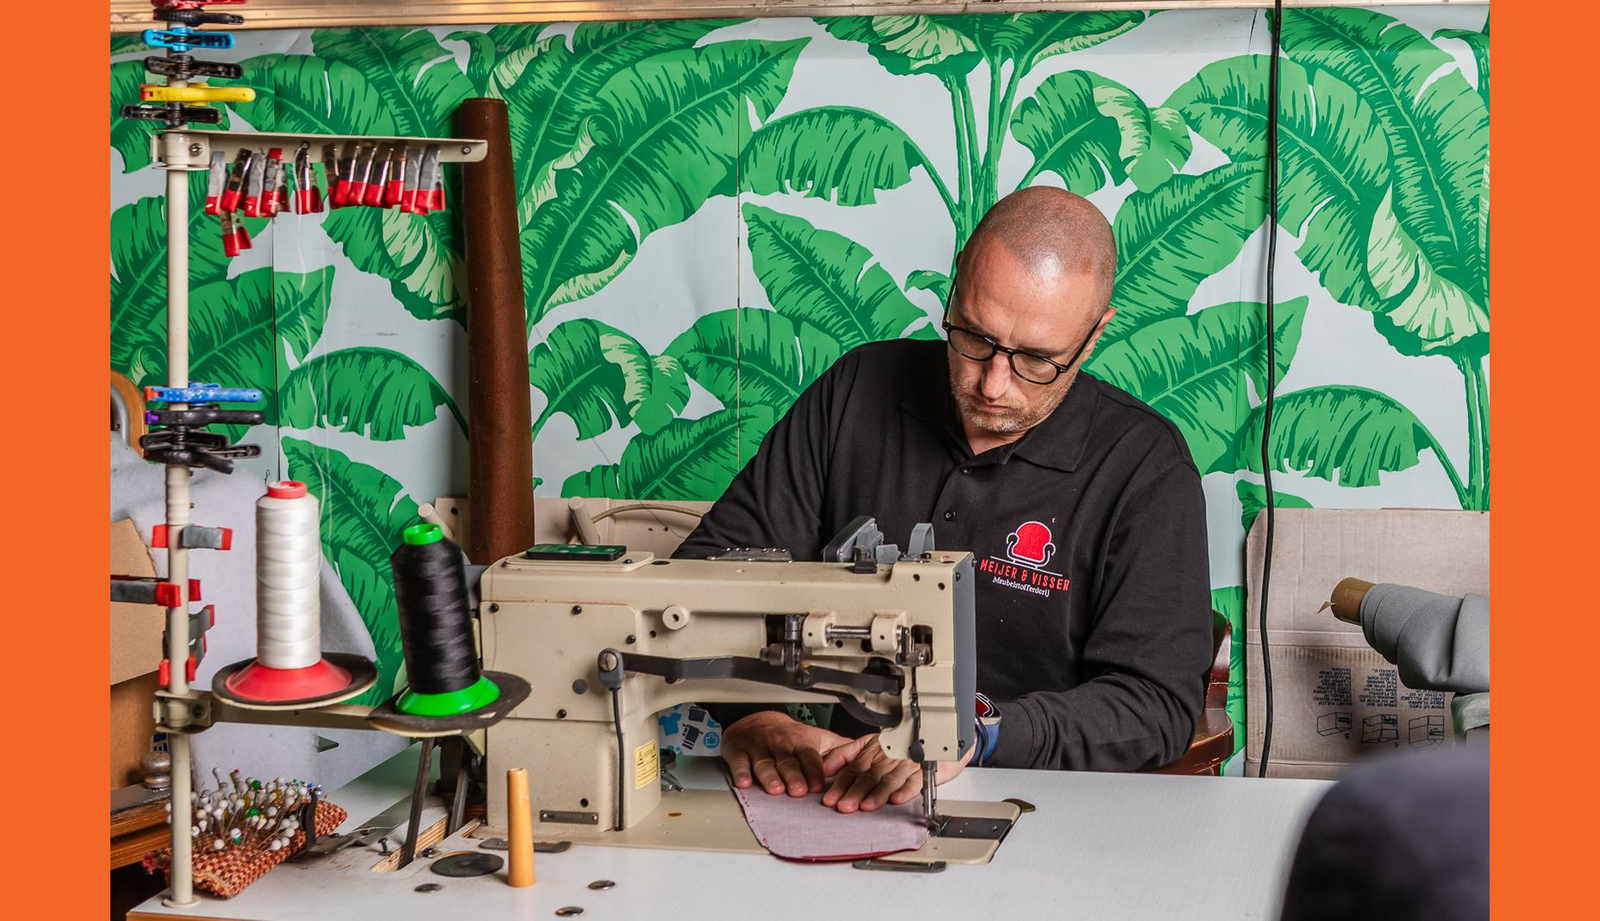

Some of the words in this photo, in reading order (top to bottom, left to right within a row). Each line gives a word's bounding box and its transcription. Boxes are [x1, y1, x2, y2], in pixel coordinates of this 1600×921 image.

[980, 559, 1018, 579] MEIJER
[1021, 569, 1028, 582] &
[1032, 572, 1070, 592] VISSER
